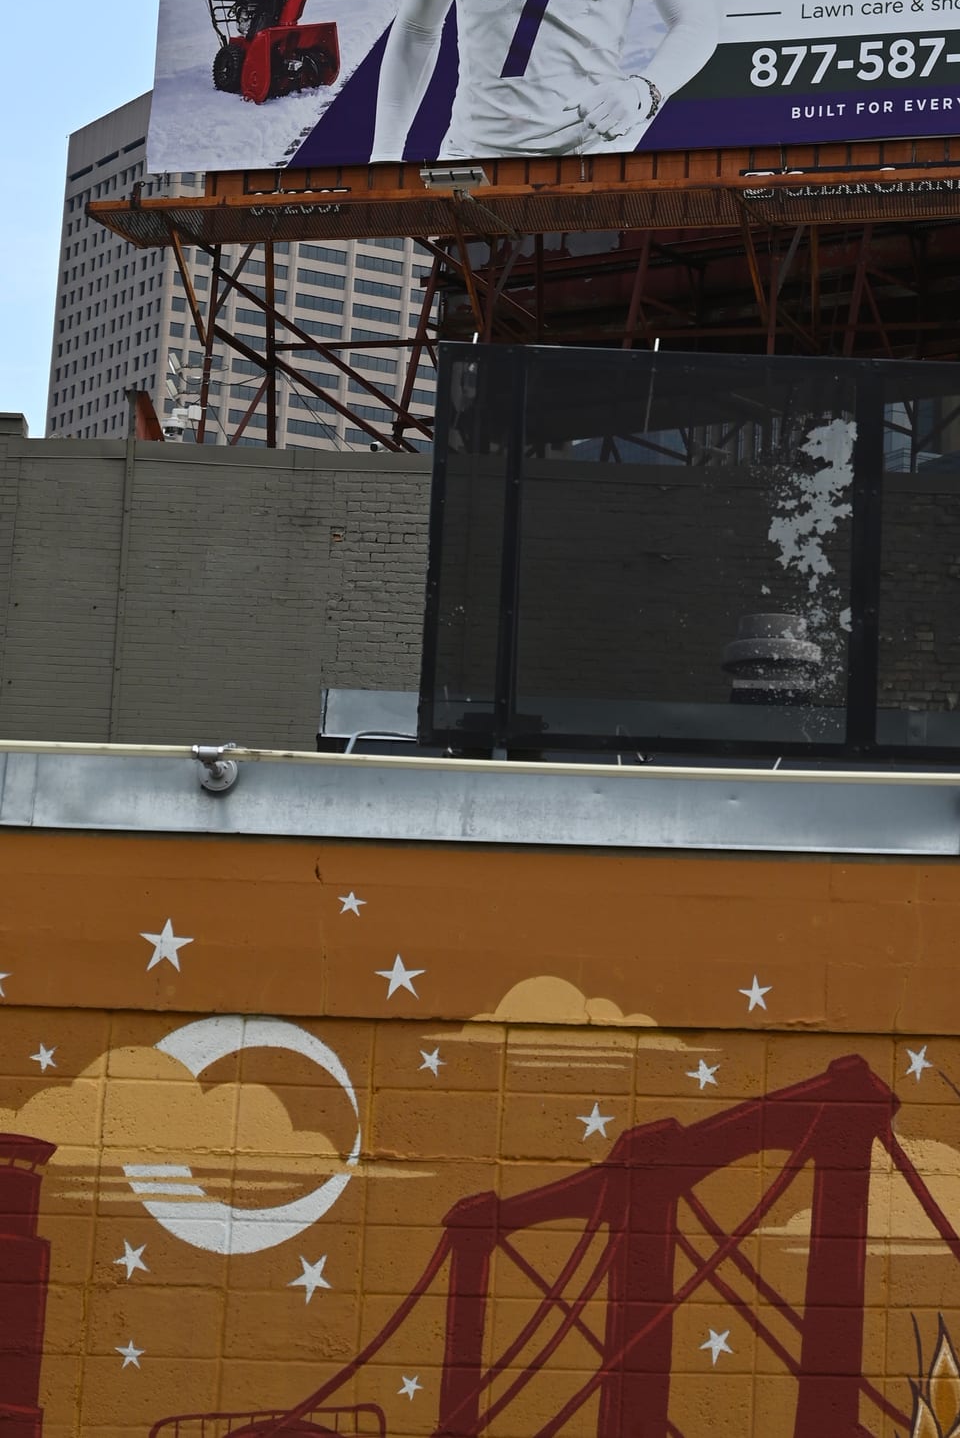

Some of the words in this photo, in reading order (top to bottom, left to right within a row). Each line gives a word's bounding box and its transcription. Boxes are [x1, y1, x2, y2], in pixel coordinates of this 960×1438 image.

[801, 2, 854, 20] Lawn
[860, 0, 904, 16] care
[791, 103, 846, 119] BUILT
[856, 101, 893, 114] FOR
